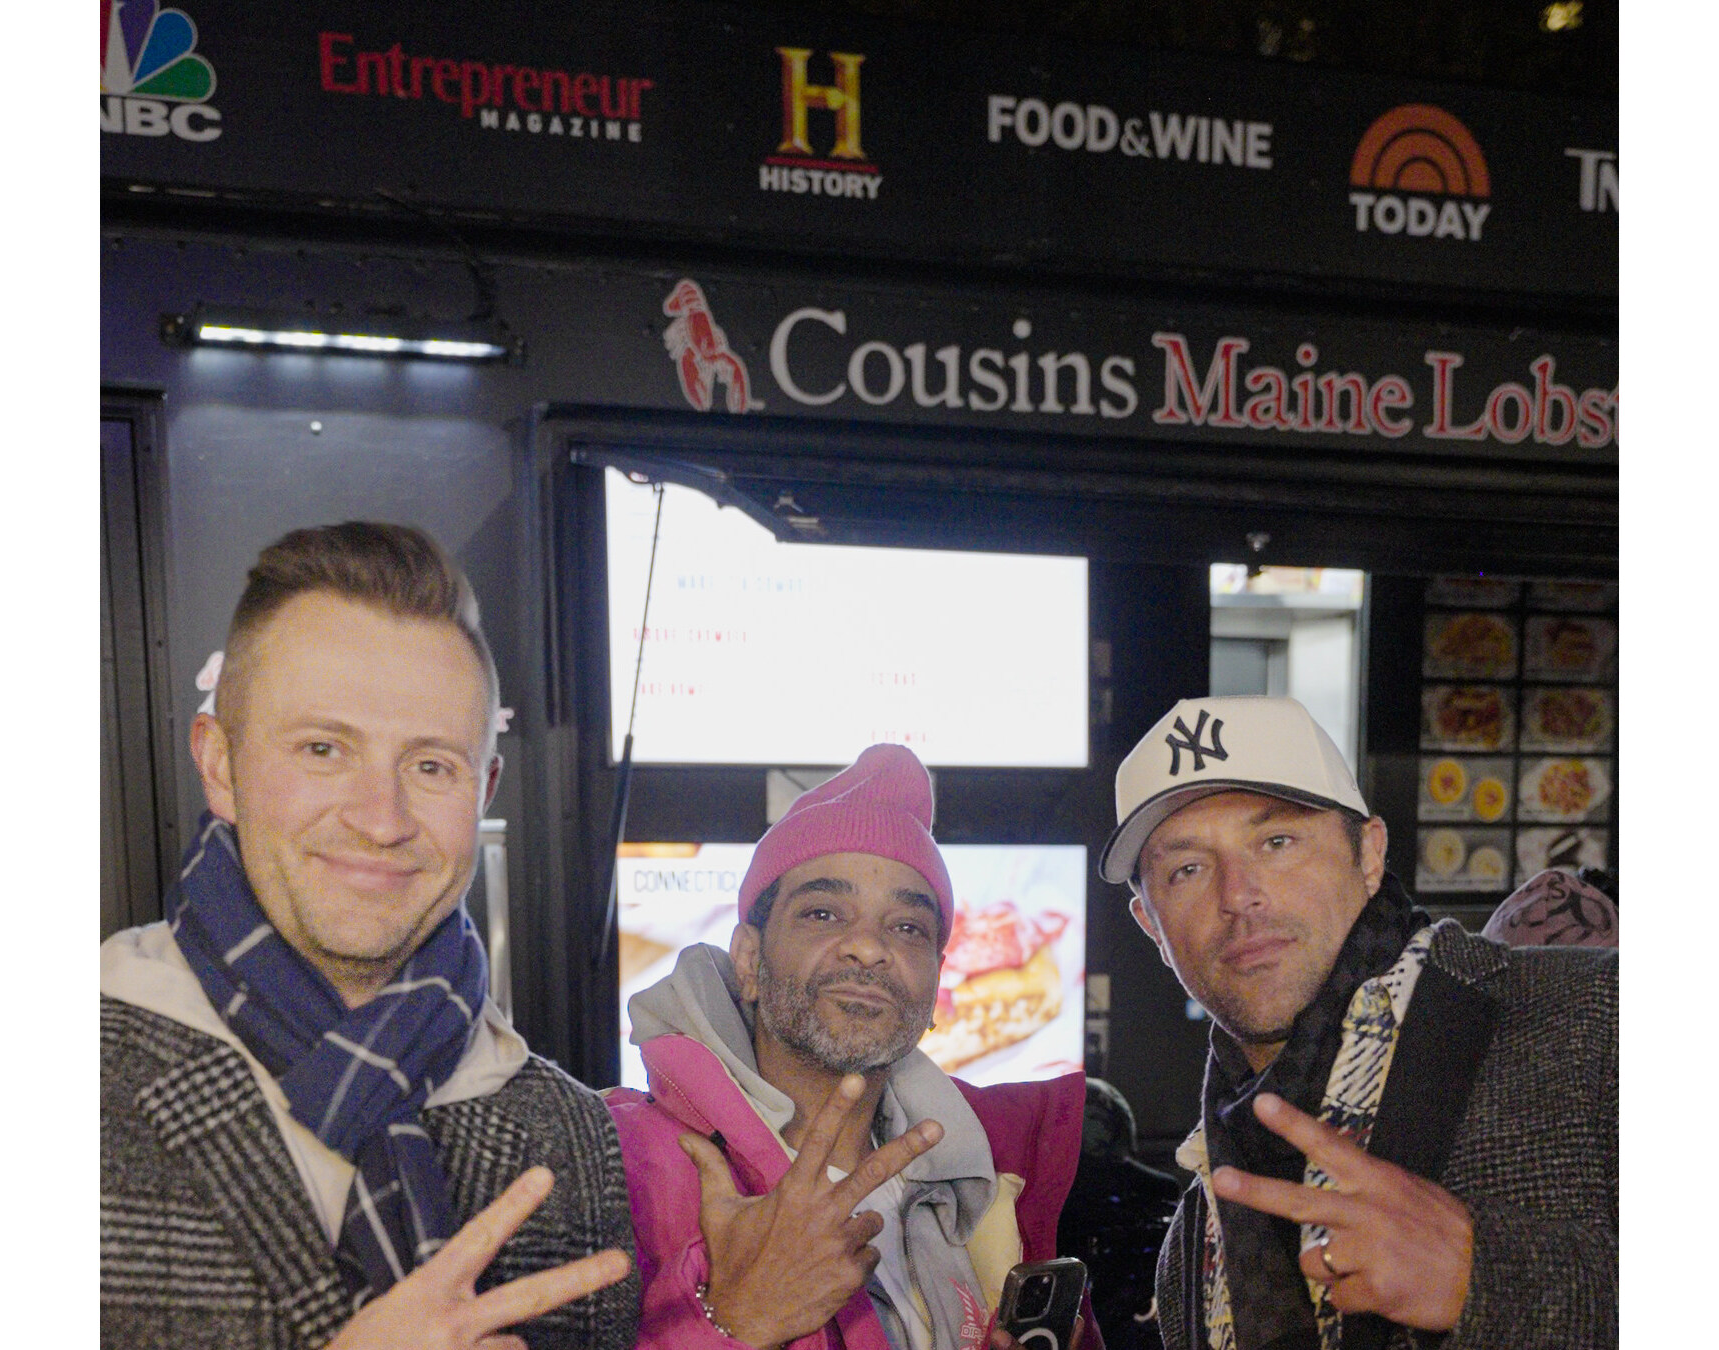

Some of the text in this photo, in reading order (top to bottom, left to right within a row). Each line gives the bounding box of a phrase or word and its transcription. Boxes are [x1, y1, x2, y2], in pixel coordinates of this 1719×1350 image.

[319, 31, 653, 119] Entrepreneur
[481, 108, 642, 142] MAGAZINE
[759, 165, 883, 199] HISTORY
[1349, 192, 1491, 241] TODAY
[769, 306, 1618, 448] Cousins Maine Lobs
[1165, 709, 1230, 776] NY
